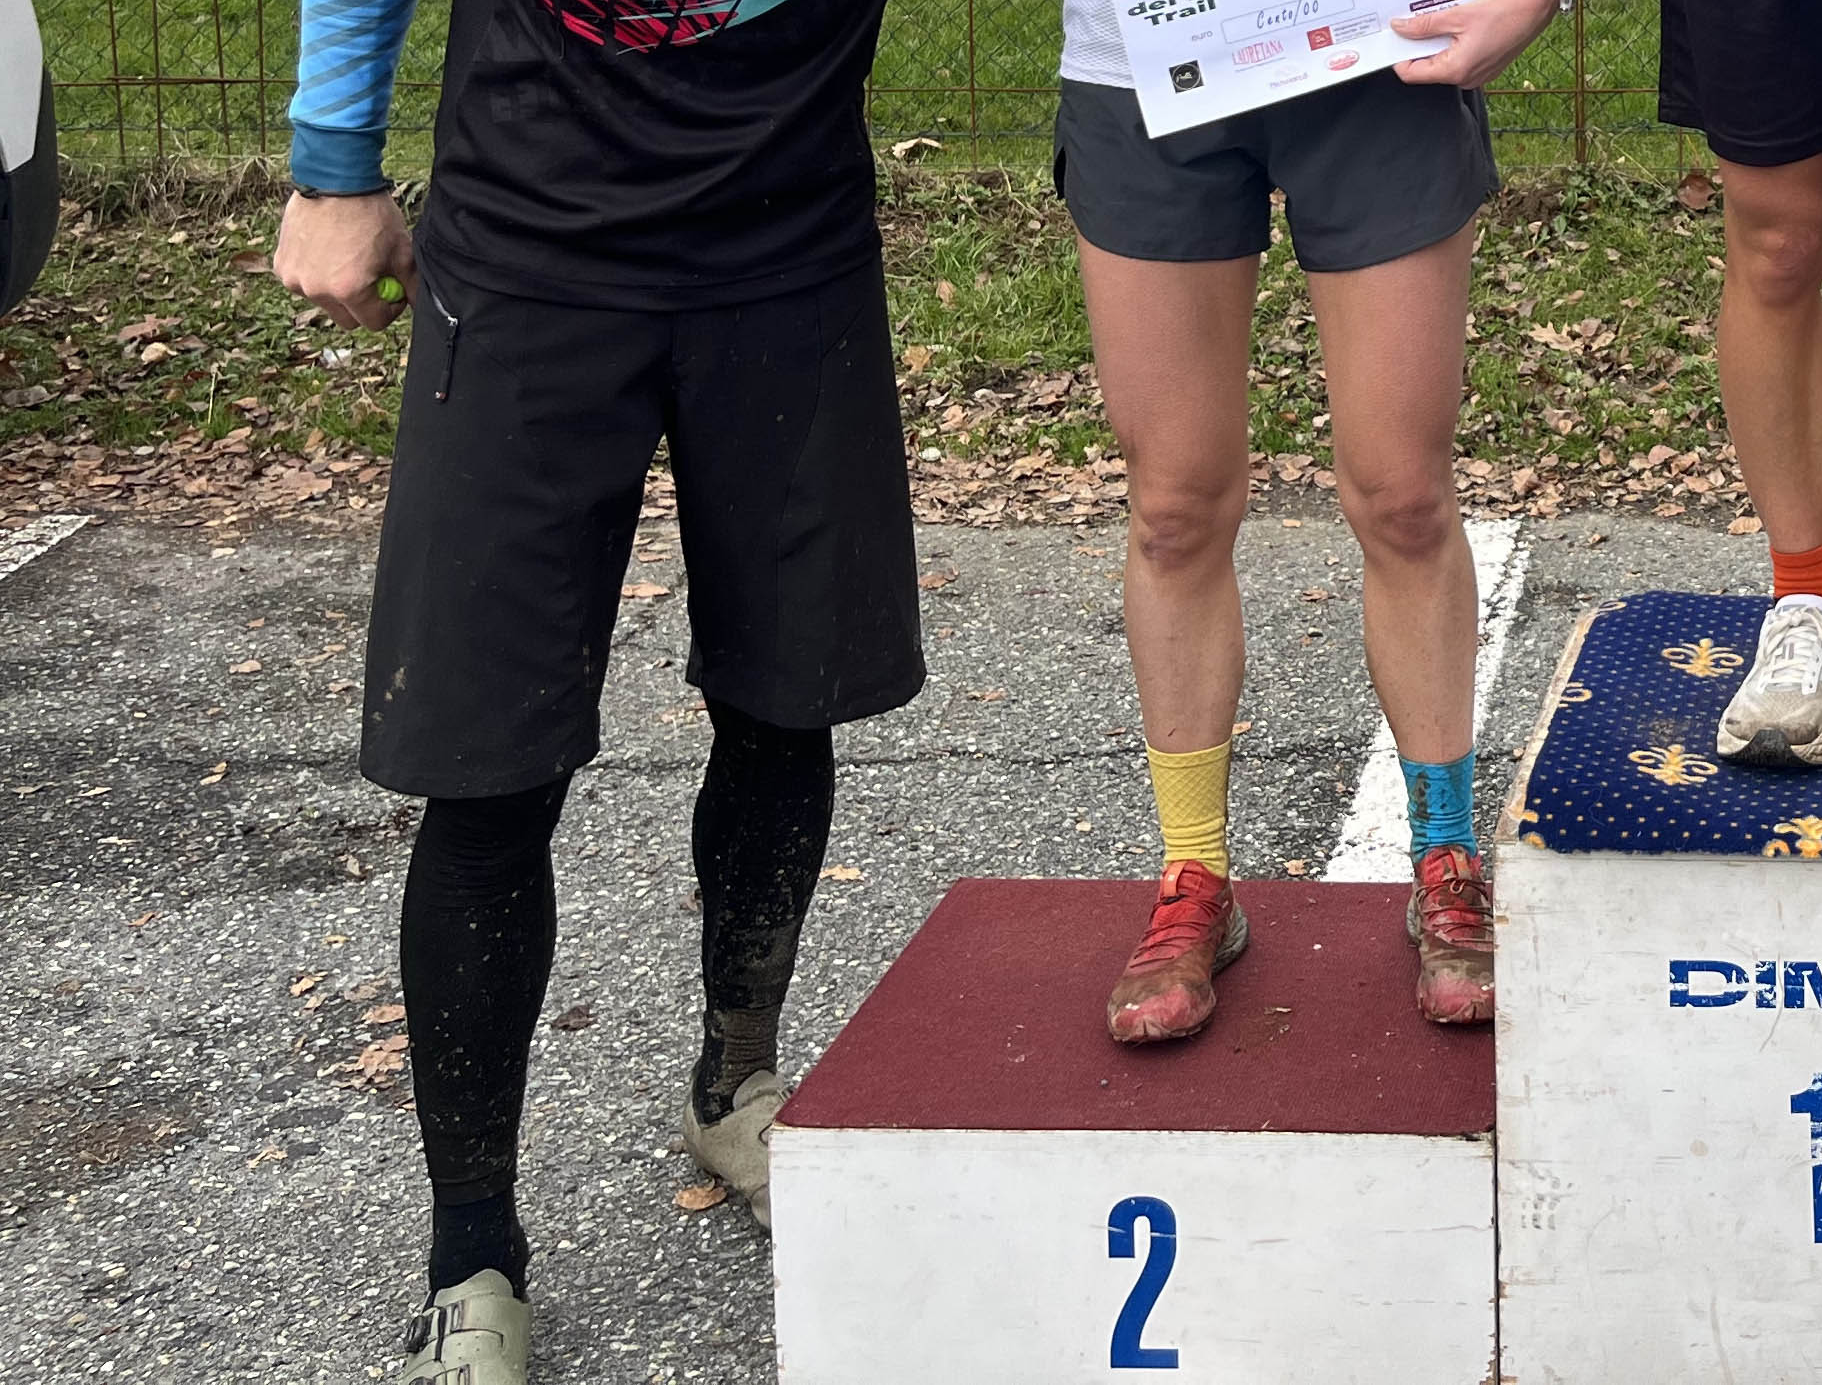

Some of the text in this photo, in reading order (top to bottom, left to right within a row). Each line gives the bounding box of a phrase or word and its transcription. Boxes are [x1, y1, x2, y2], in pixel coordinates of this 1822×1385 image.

[1191, 30, 1213, 42] euro
[1257, 0, 1319, 29] Cento/00
[1107, 1196, 1179, 1369] 2
